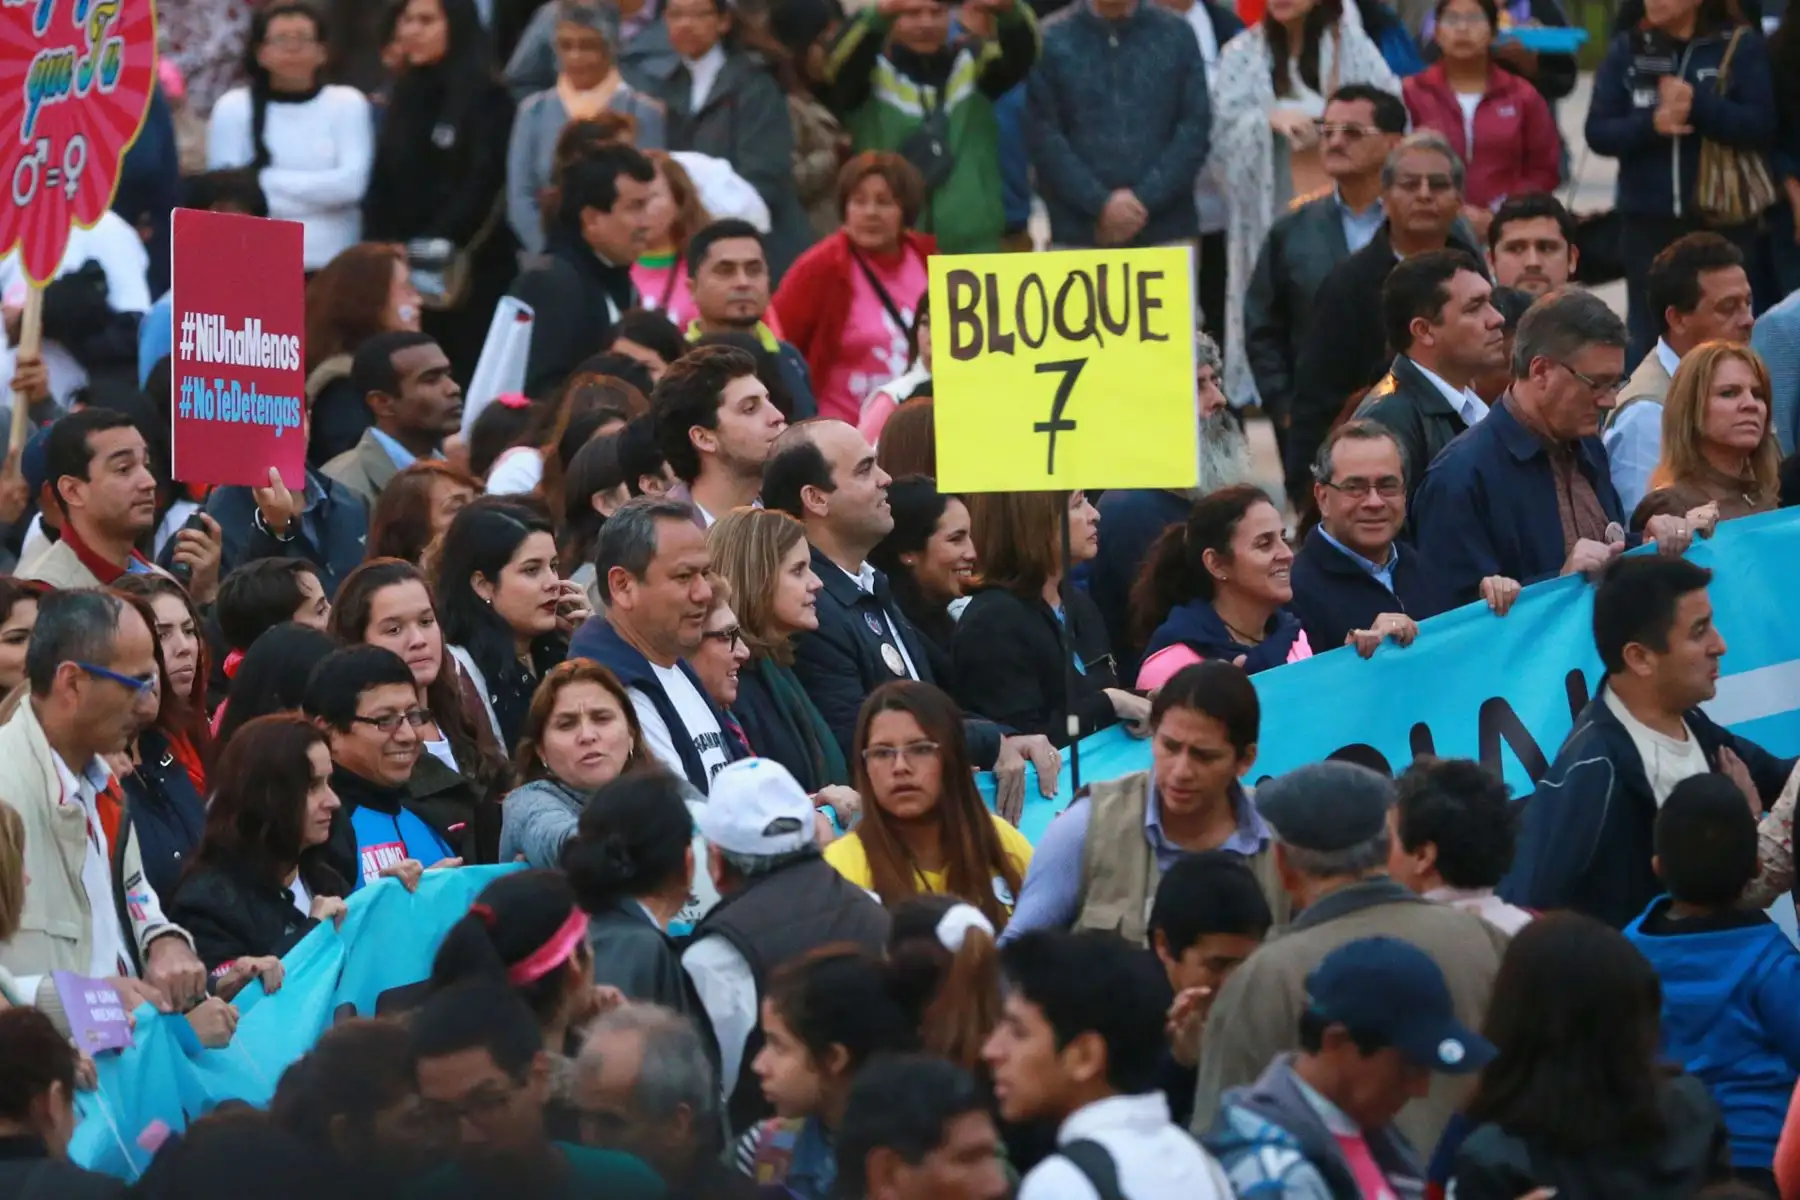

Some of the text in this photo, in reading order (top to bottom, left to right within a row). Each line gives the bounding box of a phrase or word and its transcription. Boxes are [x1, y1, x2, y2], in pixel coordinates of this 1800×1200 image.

[179, 311, 300, 371] #NiUnaMenos
[946, 262, 1169, 361] BLOQUE
[179, 375, 300, 437] #NoTeDetengas
[1033, 357, 1089, 475] 7
